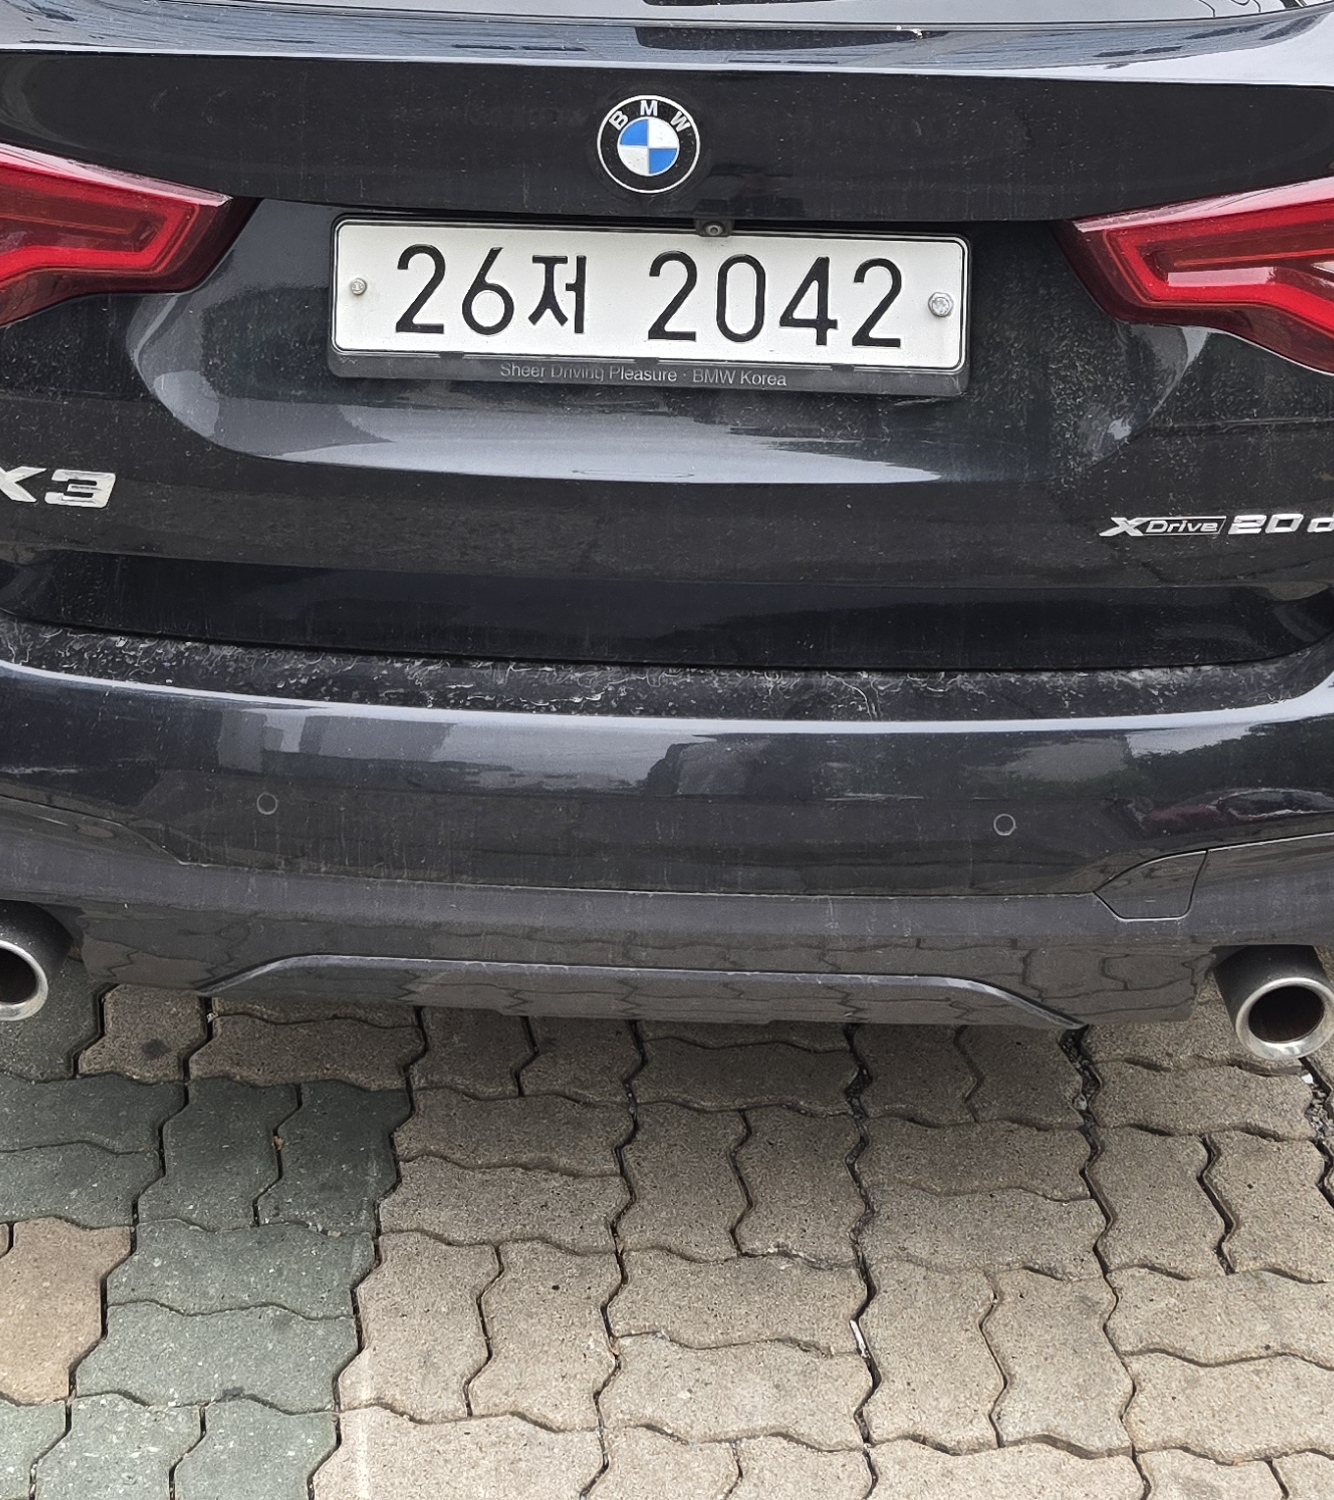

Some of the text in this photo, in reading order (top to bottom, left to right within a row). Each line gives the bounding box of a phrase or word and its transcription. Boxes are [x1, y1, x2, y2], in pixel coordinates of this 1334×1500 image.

[608, 99, 691, 133] BMW
[394, 243, 902, 349] 26저 2042
[500, 362, 787, 386] Sheer Driving Pleasure BMW Korea
